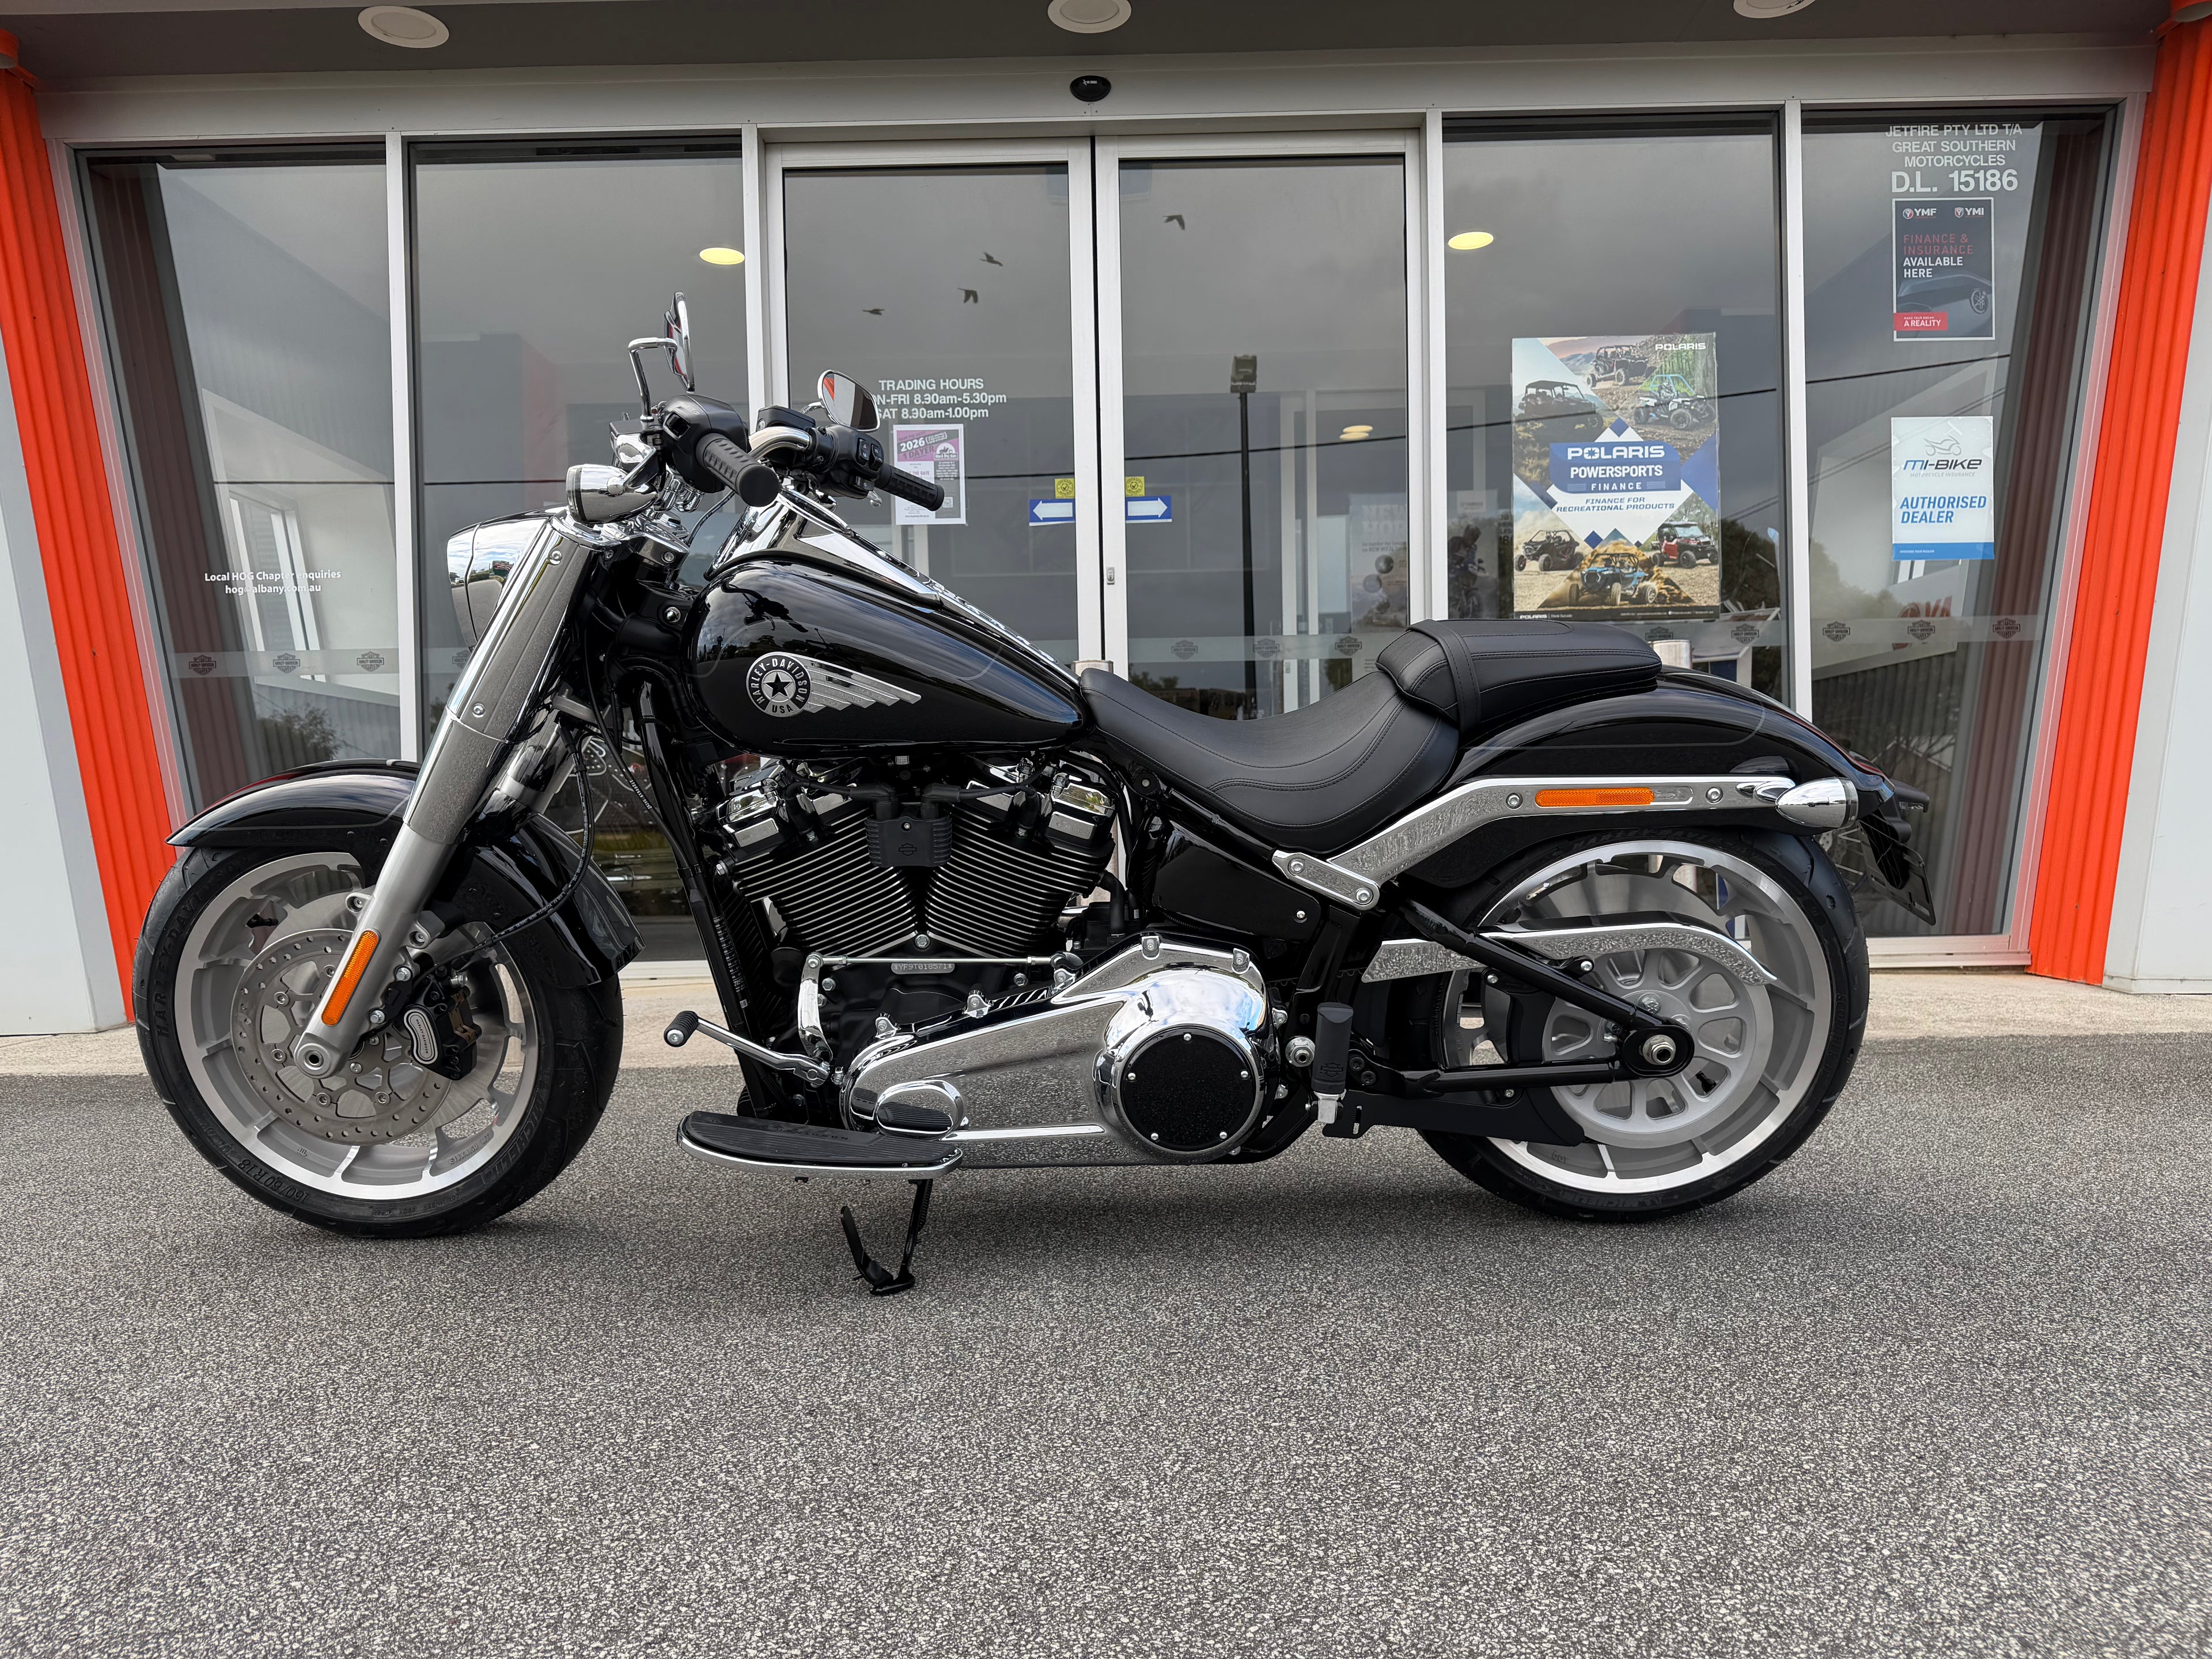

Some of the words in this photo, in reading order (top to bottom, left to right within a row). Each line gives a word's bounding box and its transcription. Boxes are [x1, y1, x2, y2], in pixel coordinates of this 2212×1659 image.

[1885, 125, 1939, 137] JETFIRE
[1944, 124, 1970, 136] PTY
[1975, 124, 1998, 135] LTD
[2002, 123, 2022, 136] T/A
[1892, 141, 1937, 153] GREAT
[1941, 140, 2016, 152] SOUTHERN
[1904, 154, 2006, 168] MOTORCYCLES
[1892, 171, 1937, 192] D.L.
[1949, 169, 2018, 192] 15186
[1914, 208, 1937, 216] YMF
[1965, 207, 1984, 215] YMI
[1904, 234, 1956, 243] FINANCE
[1960, 233, 1968, 243] &
[1904, 245, 1974, 255] INSURANCE
[1903, 257, 1963, 267] AVAILABLE
[1904, 268, 1933, 278] HERE
[878, 379, 936, 391] TRADING
[940, 378, 984, 390] HOURS
[900, 437, 926, 452] 2026
[908, 445, 934, 459] DAYER
[1567, 445, 1665, 460] POLARIS
[1570, 465, 1663, 479] POWERSPORTS
[1591, 482, 1642, 491] FINANCE
[1900, 496, 1987, 509] AUTHORISED
[1901, 510, 1954, 524] DEALER
[204, 573, 230, 582] Local
[232, 572, 255, 581] HOG
[256, 571, 294, 583] Chapter
[296, 570, 341, 581] enquiries
[225, 584, 321, 596] hog@albany.com.au
[751, 658, 808, 704] HARLEY-DAVIDSON
[771, 703, 794, 714] USA
[237, 1158, 268, 1181] R18
[264, 1176, 311, 1204] 160/60
